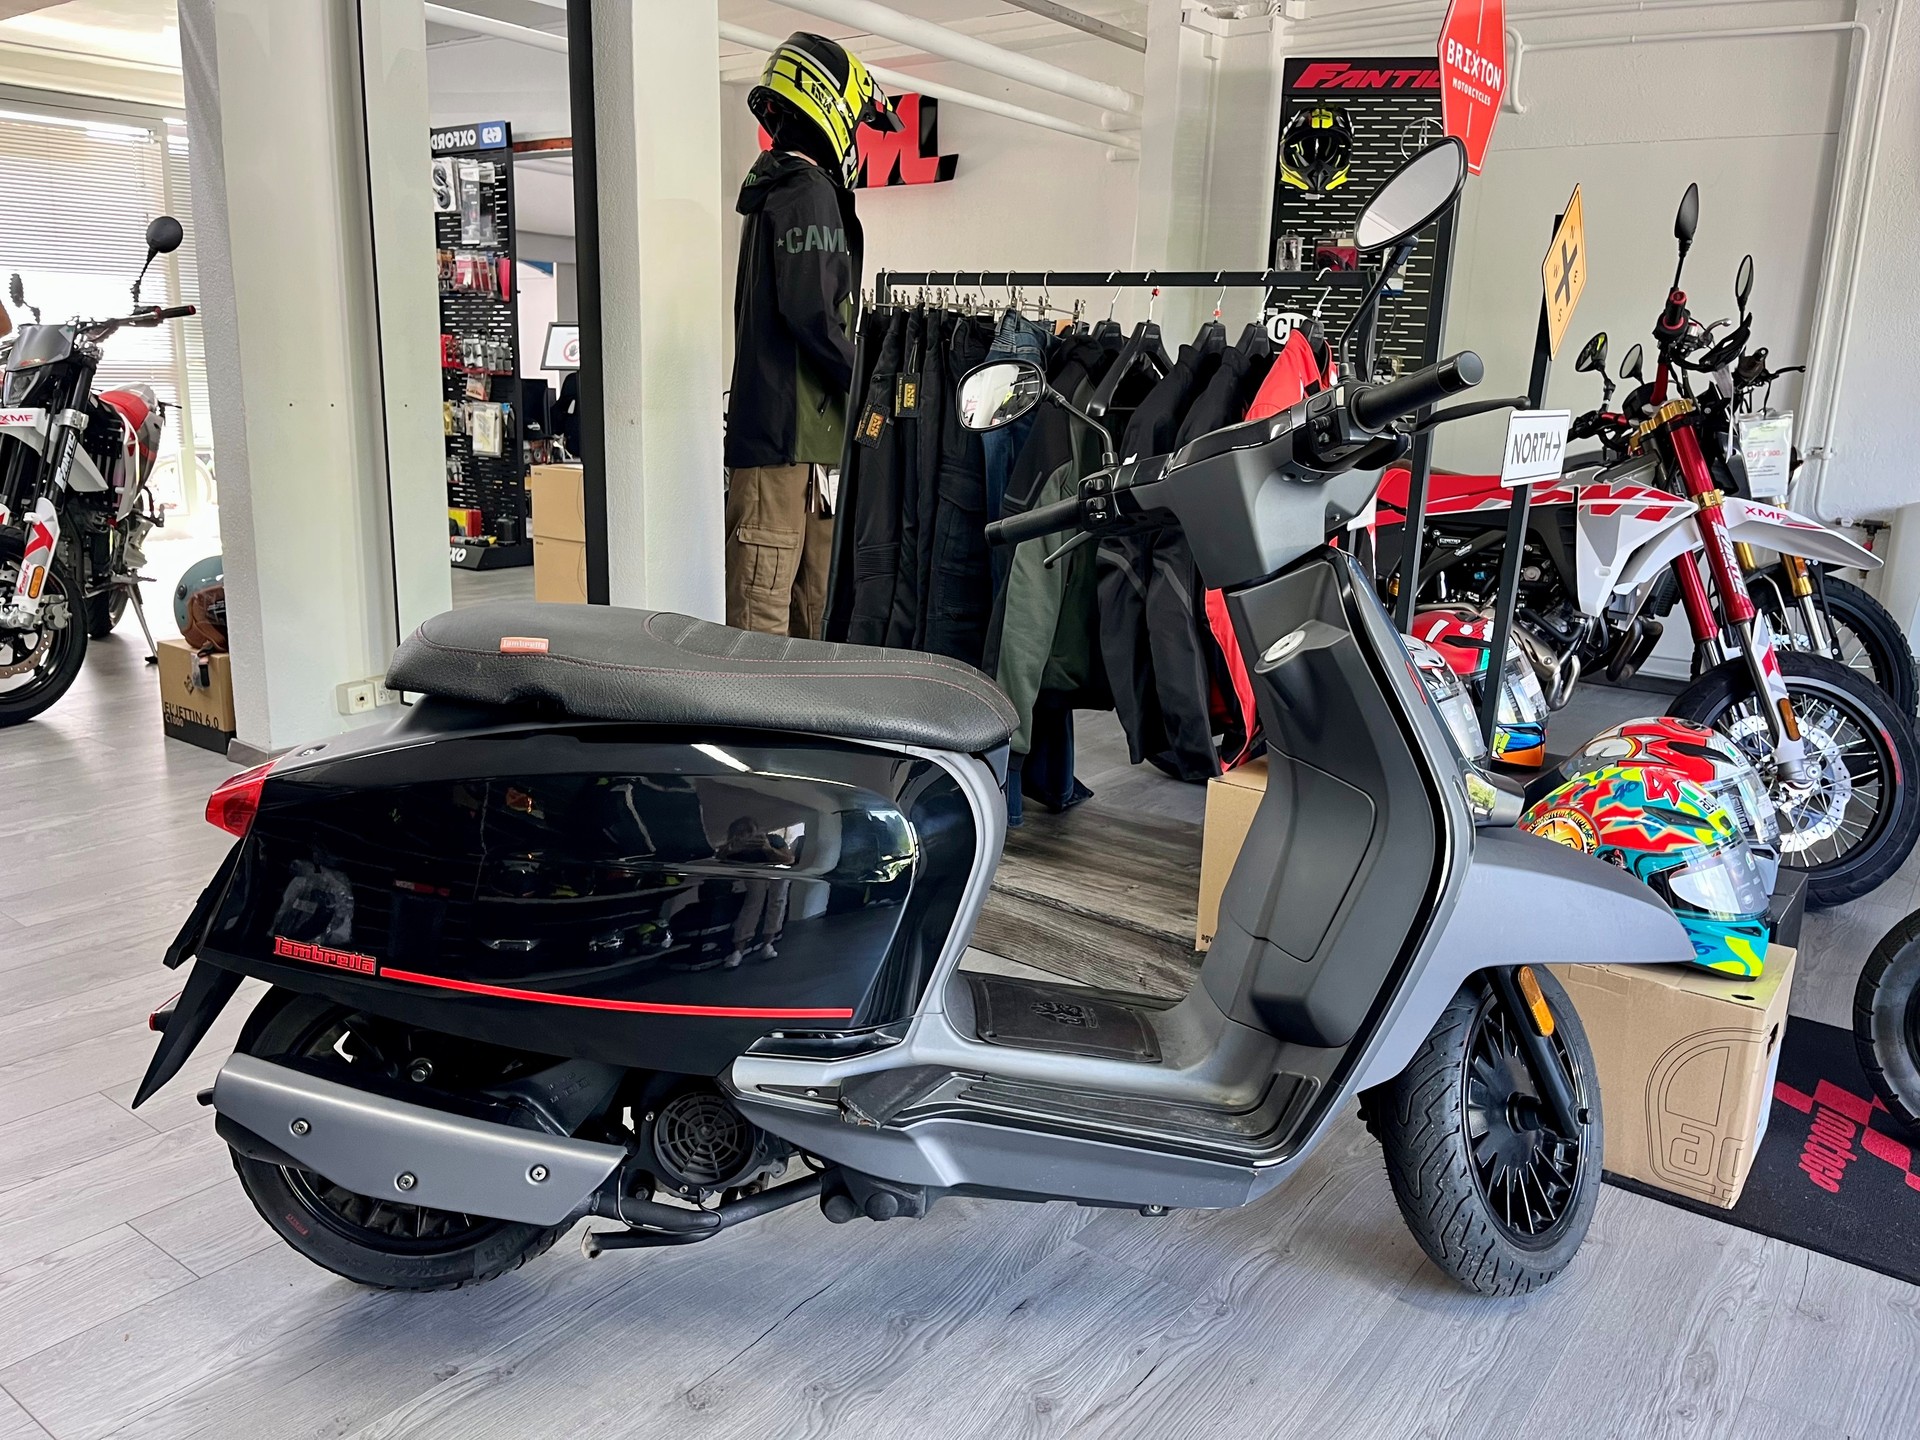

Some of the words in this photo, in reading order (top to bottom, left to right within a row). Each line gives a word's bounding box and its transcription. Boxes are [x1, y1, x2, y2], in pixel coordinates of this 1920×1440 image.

[1446, 37, 1502, 92] BRIXTON
[1452, 76, 1491, 107] MOTORCYCLES
[1, 414, 33, 423] XMF
[1510, 431, 1554, 465] NORTH
[1744, 505, 1788, 521] XMF
[1799, 1106, 1857, 1194] motogp
